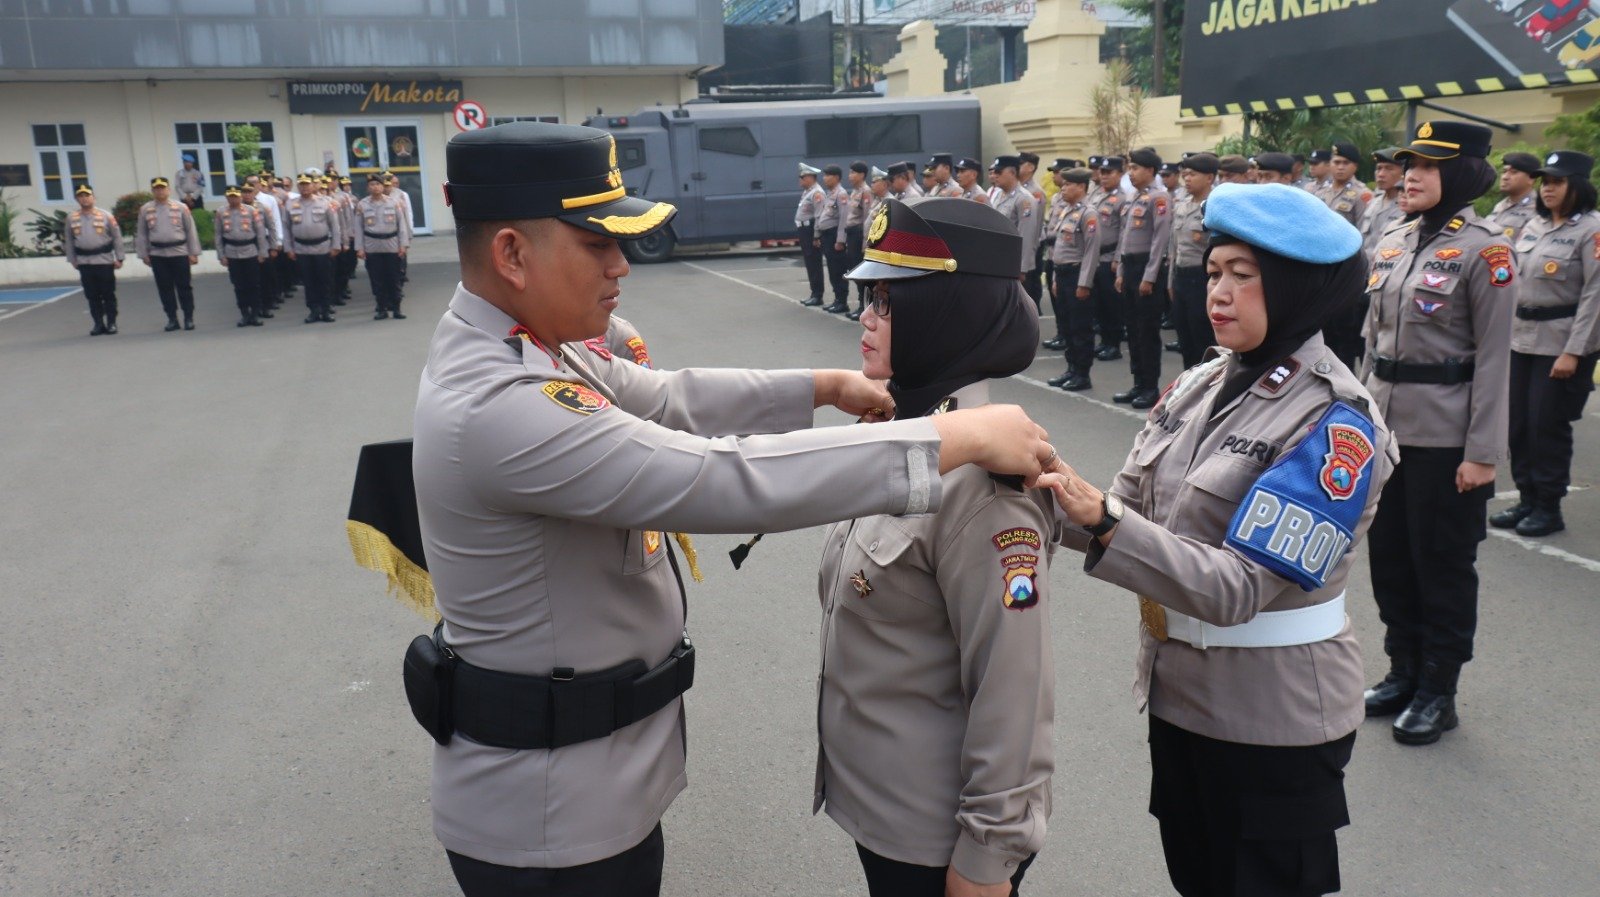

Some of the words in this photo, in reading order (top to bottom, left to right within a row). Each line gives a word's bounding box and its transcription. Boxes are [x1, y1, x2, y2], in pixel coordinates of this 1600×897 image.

[1201, 0, 1277, 36] JAGA
[292, 83, 367, 96] PRIMKOPPOL
[360, 80, 460, 112] Makota
[1422, 260, 1463, 273] POLRI
[1220, 434, 1277, 464] POLRI
[997, 530, 1039, 542] POLRESTA
